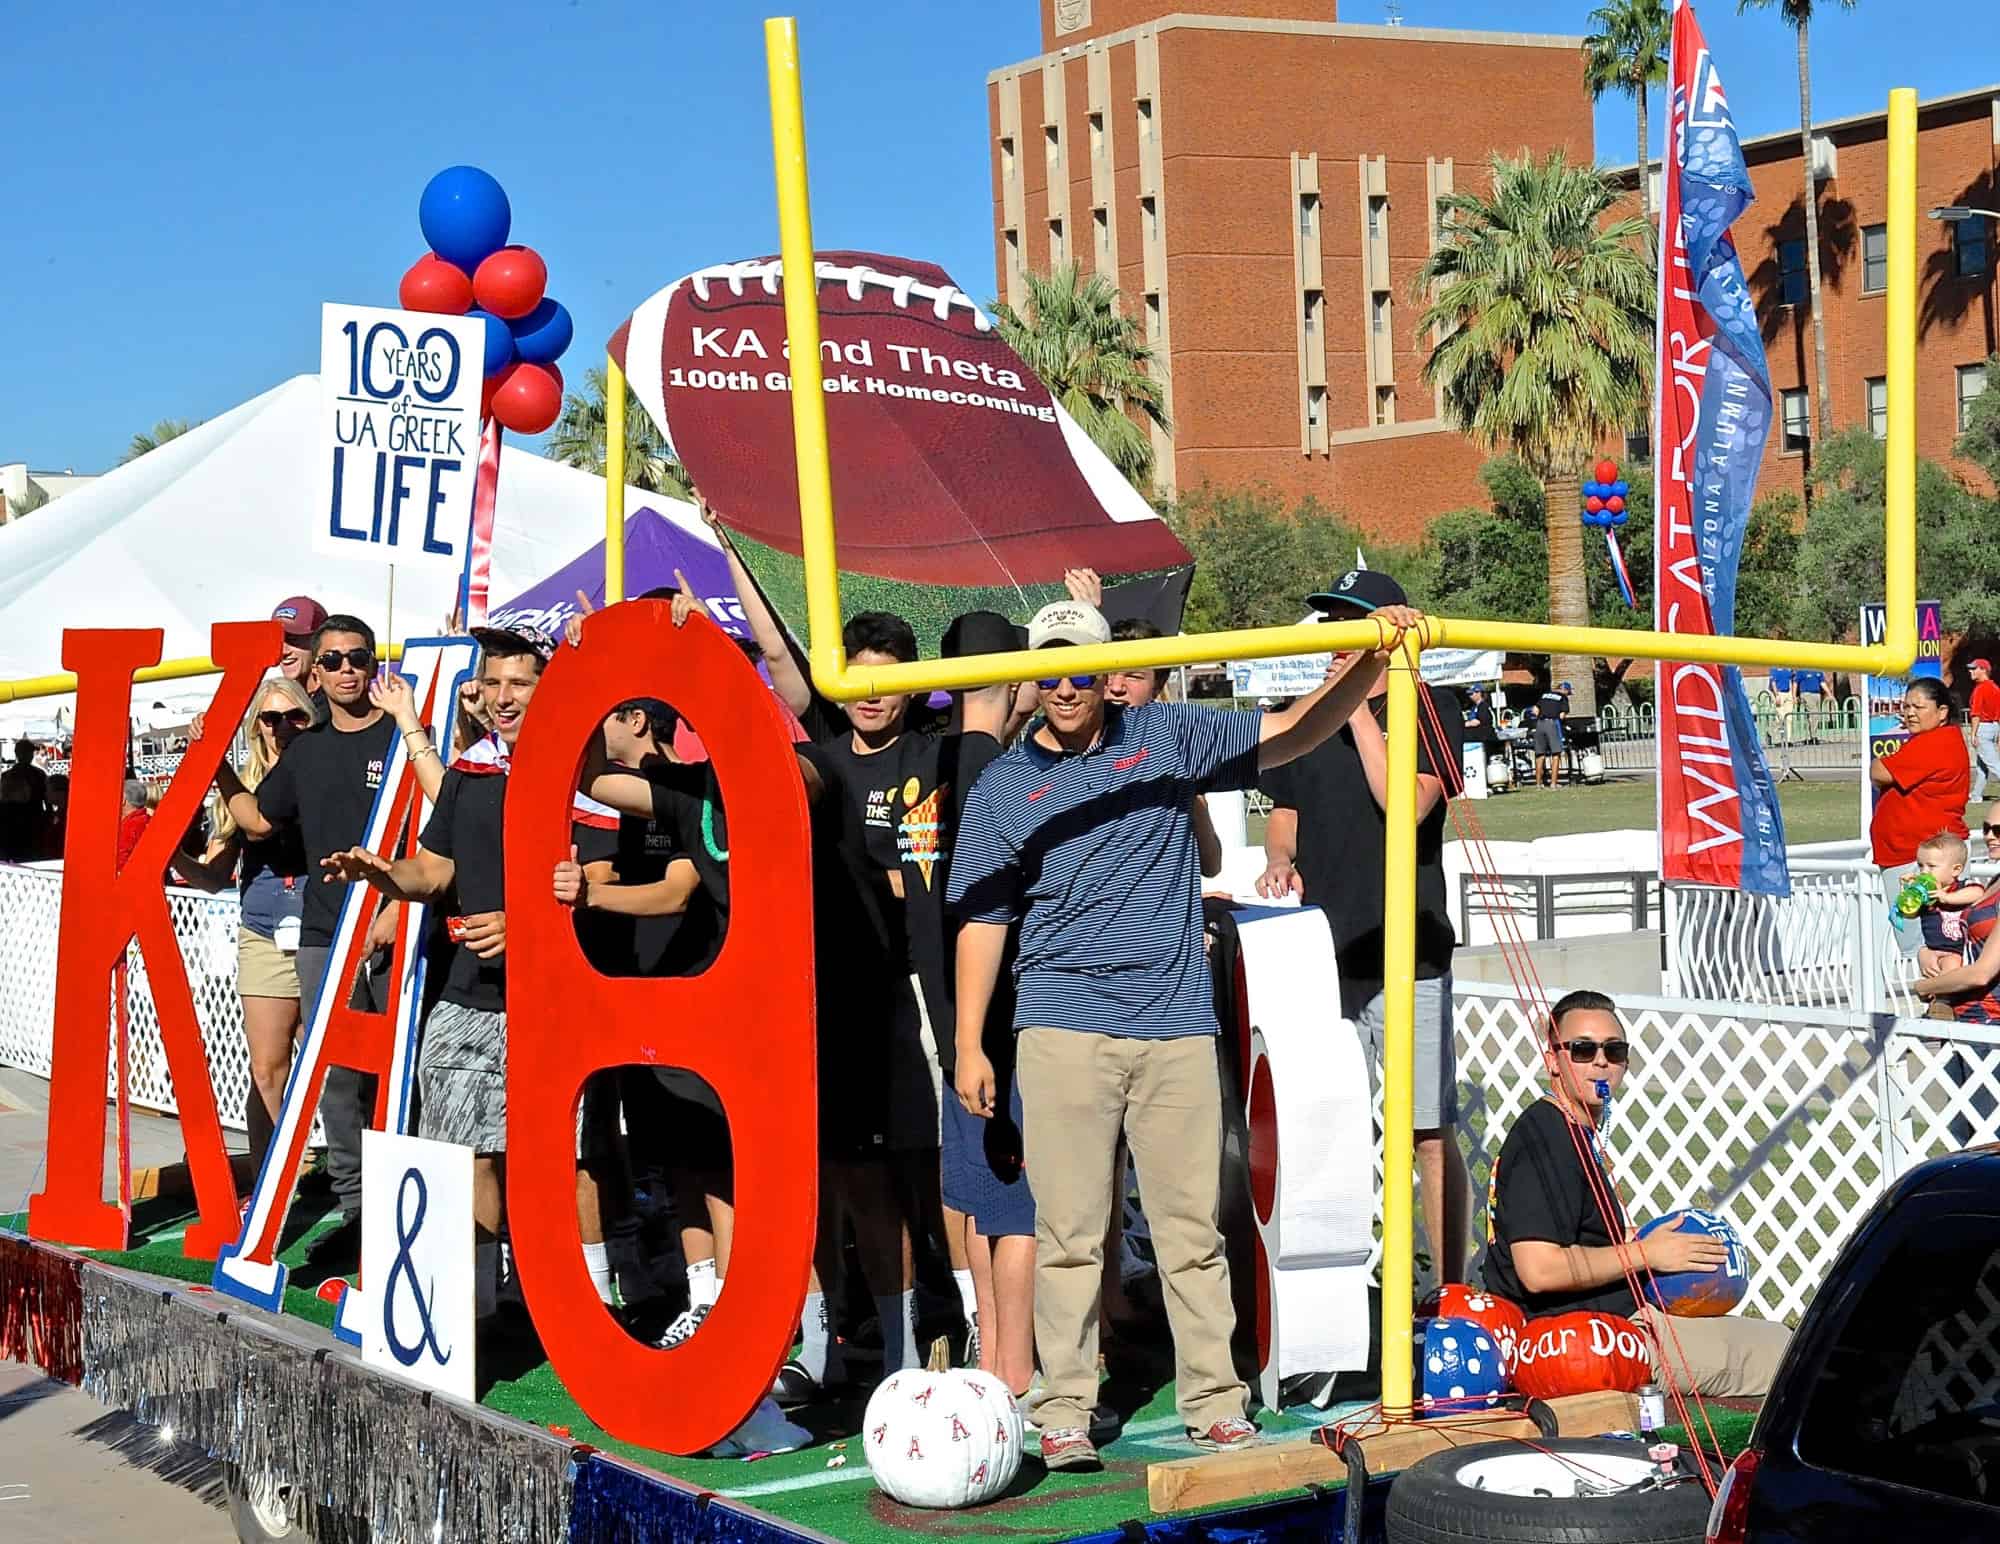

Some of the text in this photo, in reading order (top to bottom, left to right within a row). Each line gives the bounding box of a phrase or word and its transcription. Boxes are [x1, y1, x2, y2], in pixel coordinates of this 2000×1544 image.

[342, 321, 460, 403] 100
[383, 347, 442, 382] YEARS
[691, 327, 769, 359] KA
[886, 343, 1026, 392] Theta
[391, 394, 412, 414] of
[669, 367, 759, 391] 100th
[864, 376, 1058, 423] Homecoming
[1711, 369, 1751, 467] ALUMNI
[335, 409, 465, 456] UA GREEK
[330, 446, 462, 556] LIFE
[1702, 484, 1722, 595] ARIZONA
[866, 804, 891, 819] THE
[383, 1167, 452, 1366] &
